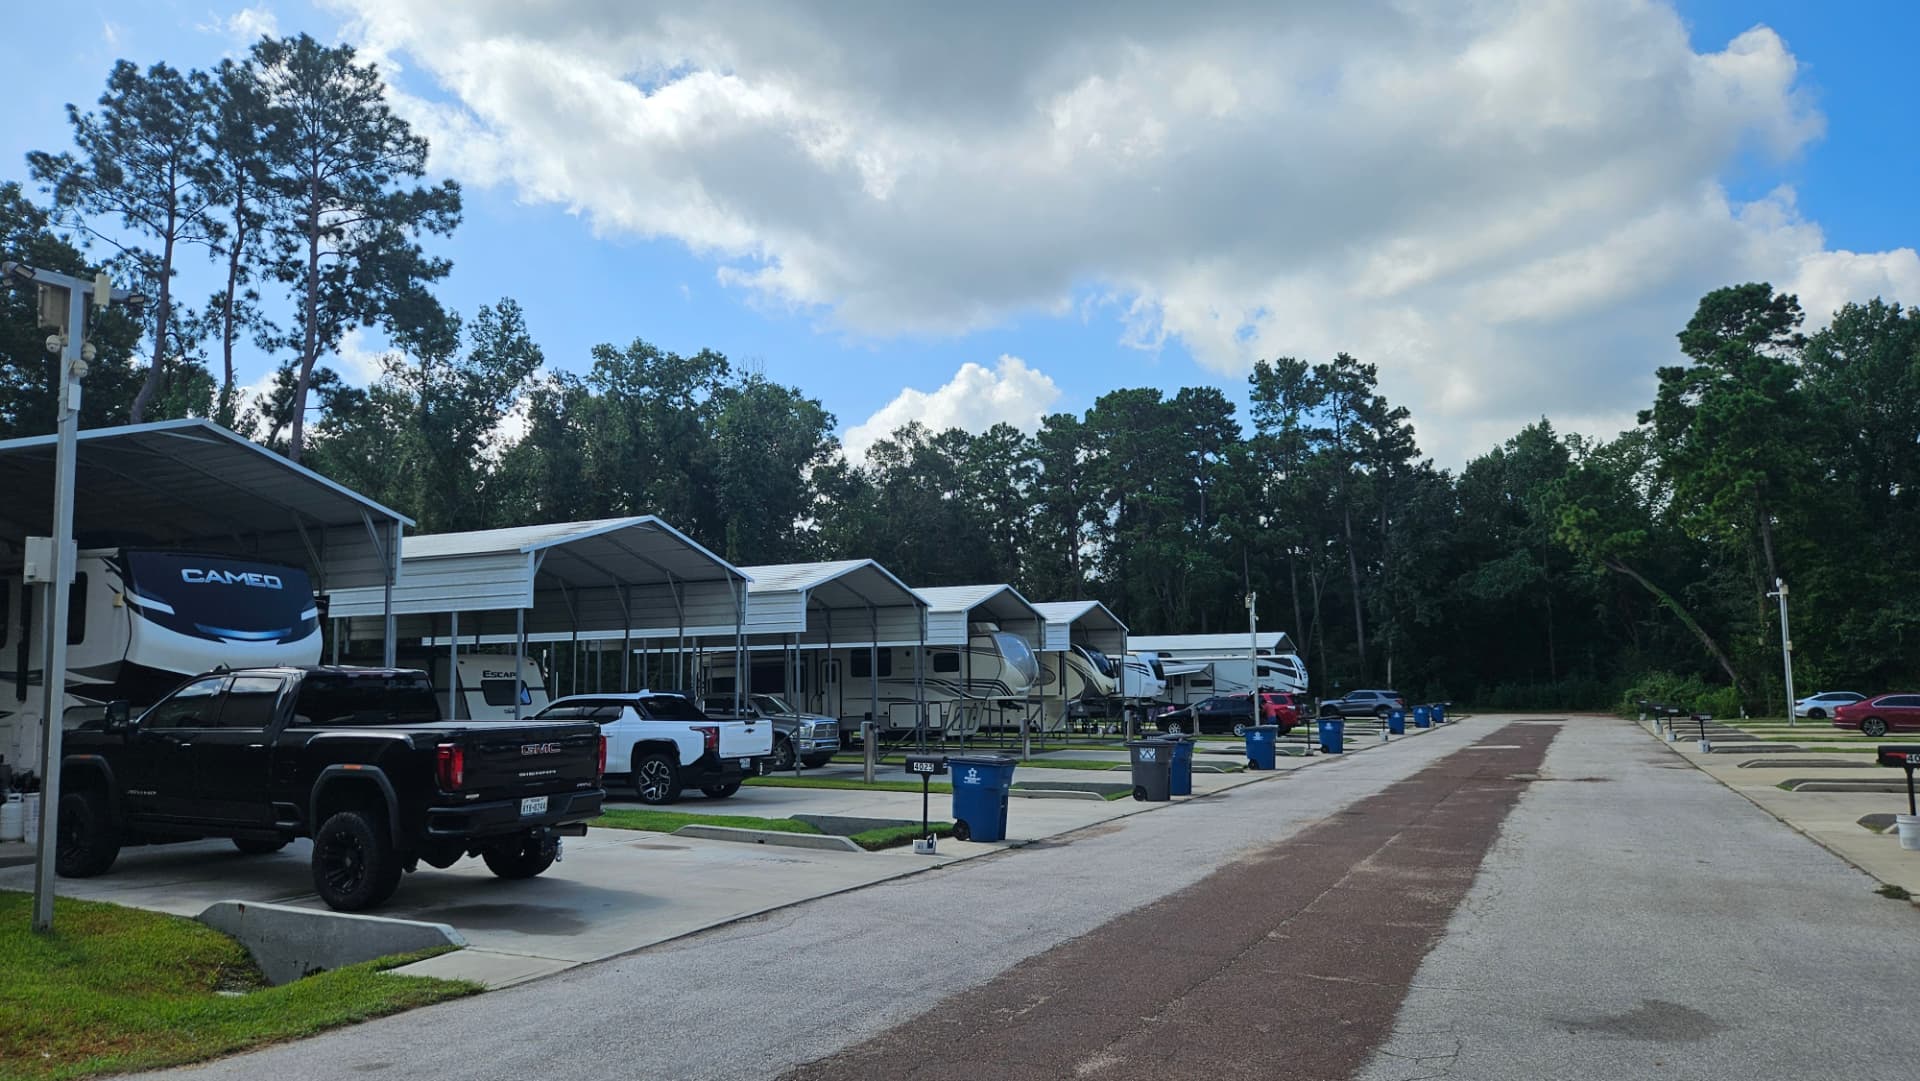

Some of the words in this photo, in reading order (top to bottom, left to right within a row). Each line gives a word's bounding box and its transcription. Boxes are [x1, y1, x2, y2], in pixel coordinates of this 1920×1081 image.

[181, 569, 282, 589] CAMEO
[483, 670, 517, 678] ESCAP
[521, 743, 560, 755] GMC
